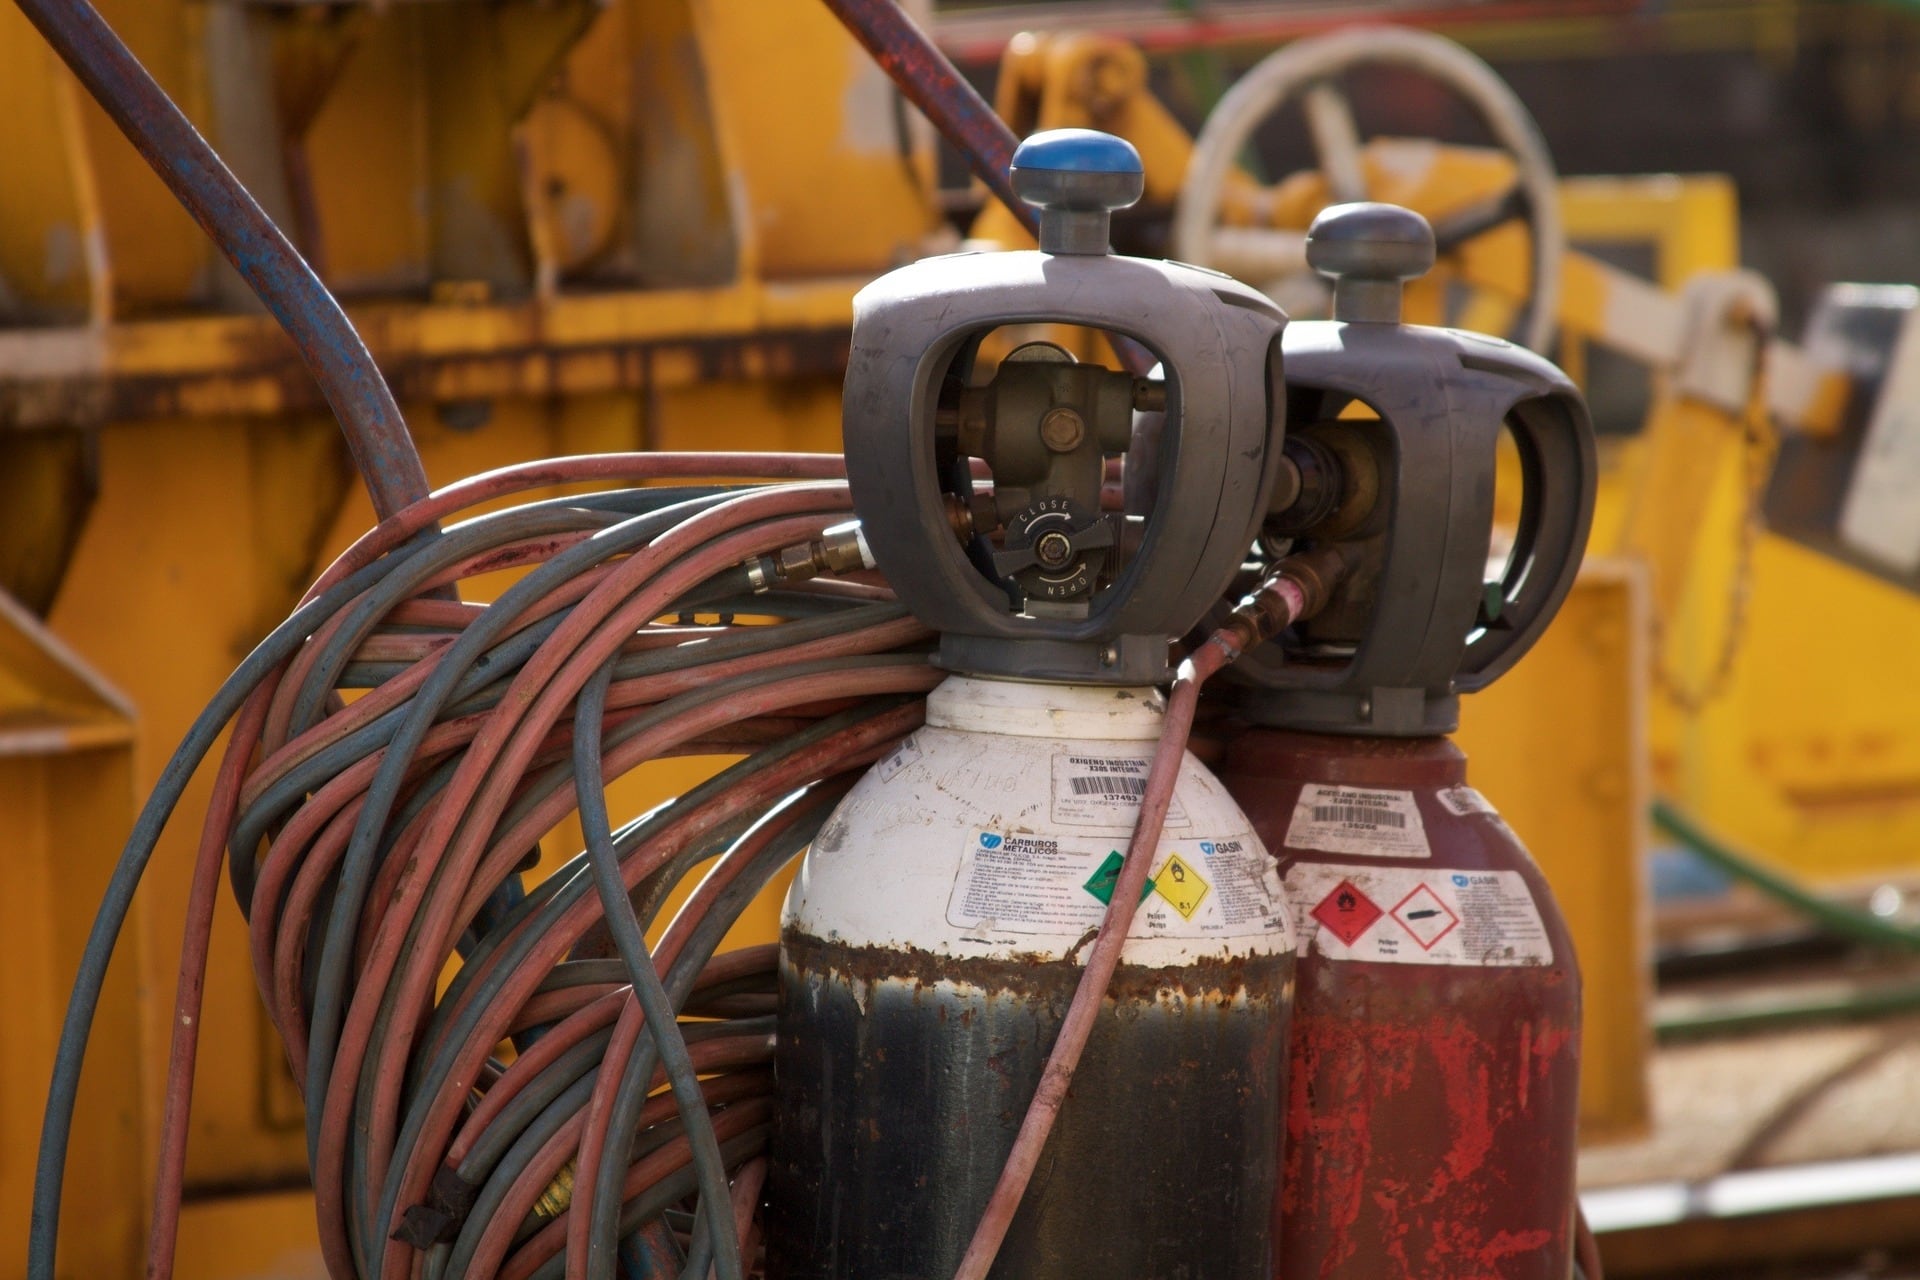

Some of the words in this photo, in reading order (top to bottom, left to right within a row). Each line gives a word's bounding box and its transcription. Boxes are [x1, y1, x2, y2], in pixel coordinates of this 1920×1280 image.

[1019, 500, 1069, 522] CLOSE
[1047, 576, 1087, 596] OPEN
[1105, 759, 1147, 768] INDUSTRIAL
[1103, 794, 1138, 802] 137493
[1004, 836, 1058, 848] CARBUROS
[1215, 840, 1244, 854] GASIN
[1179, 901, 1191, 910] 5.1
